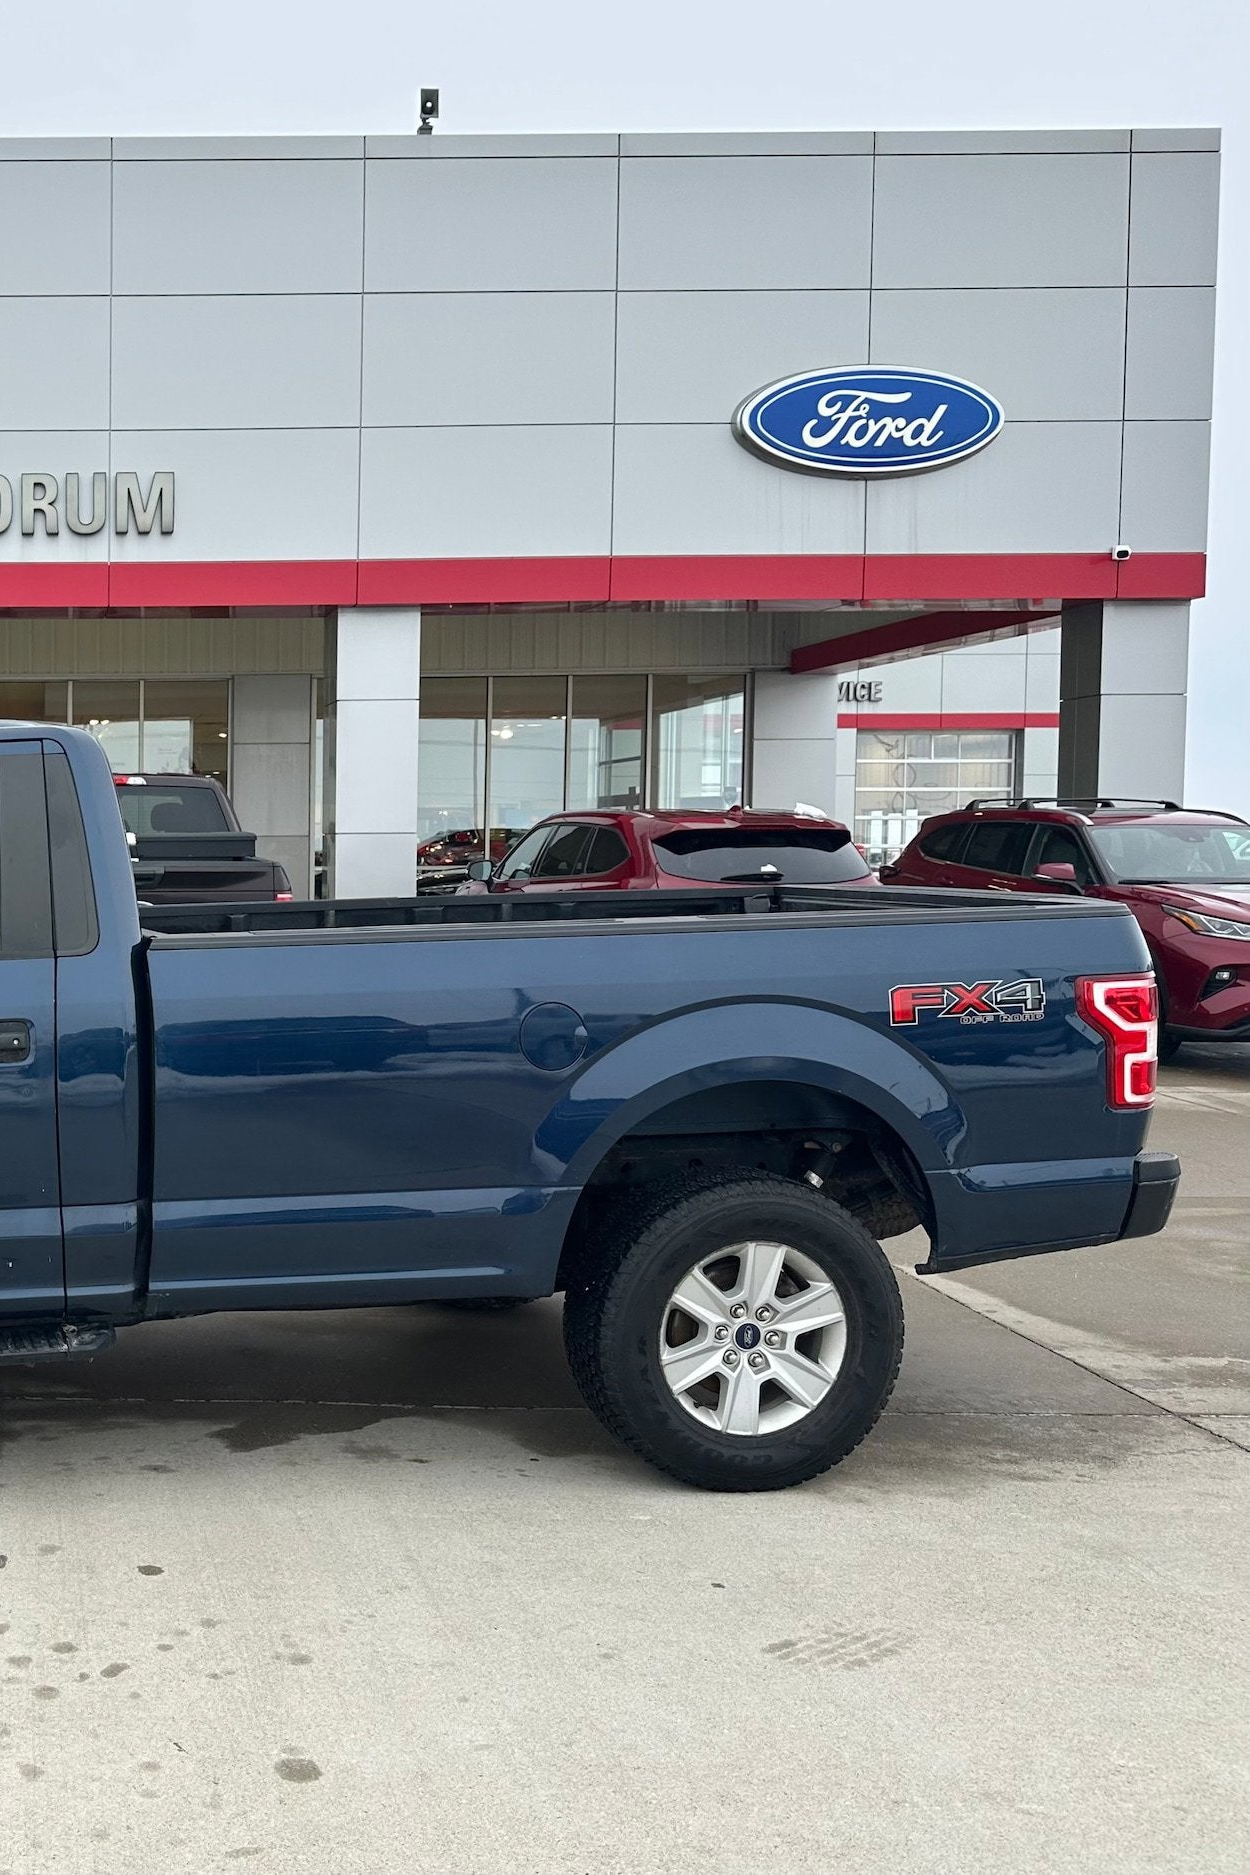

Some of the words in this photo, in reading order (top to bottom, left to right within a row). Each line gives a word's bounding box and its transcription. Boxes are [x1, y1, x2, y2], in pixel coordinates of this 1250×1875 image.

[802, 389, 948, 448] Ford
[889, 978, 1046, 1026] FX4
[960, 1016, 994, 1025] OFF
[1000, 1013, 1044, 1023] ROAD
